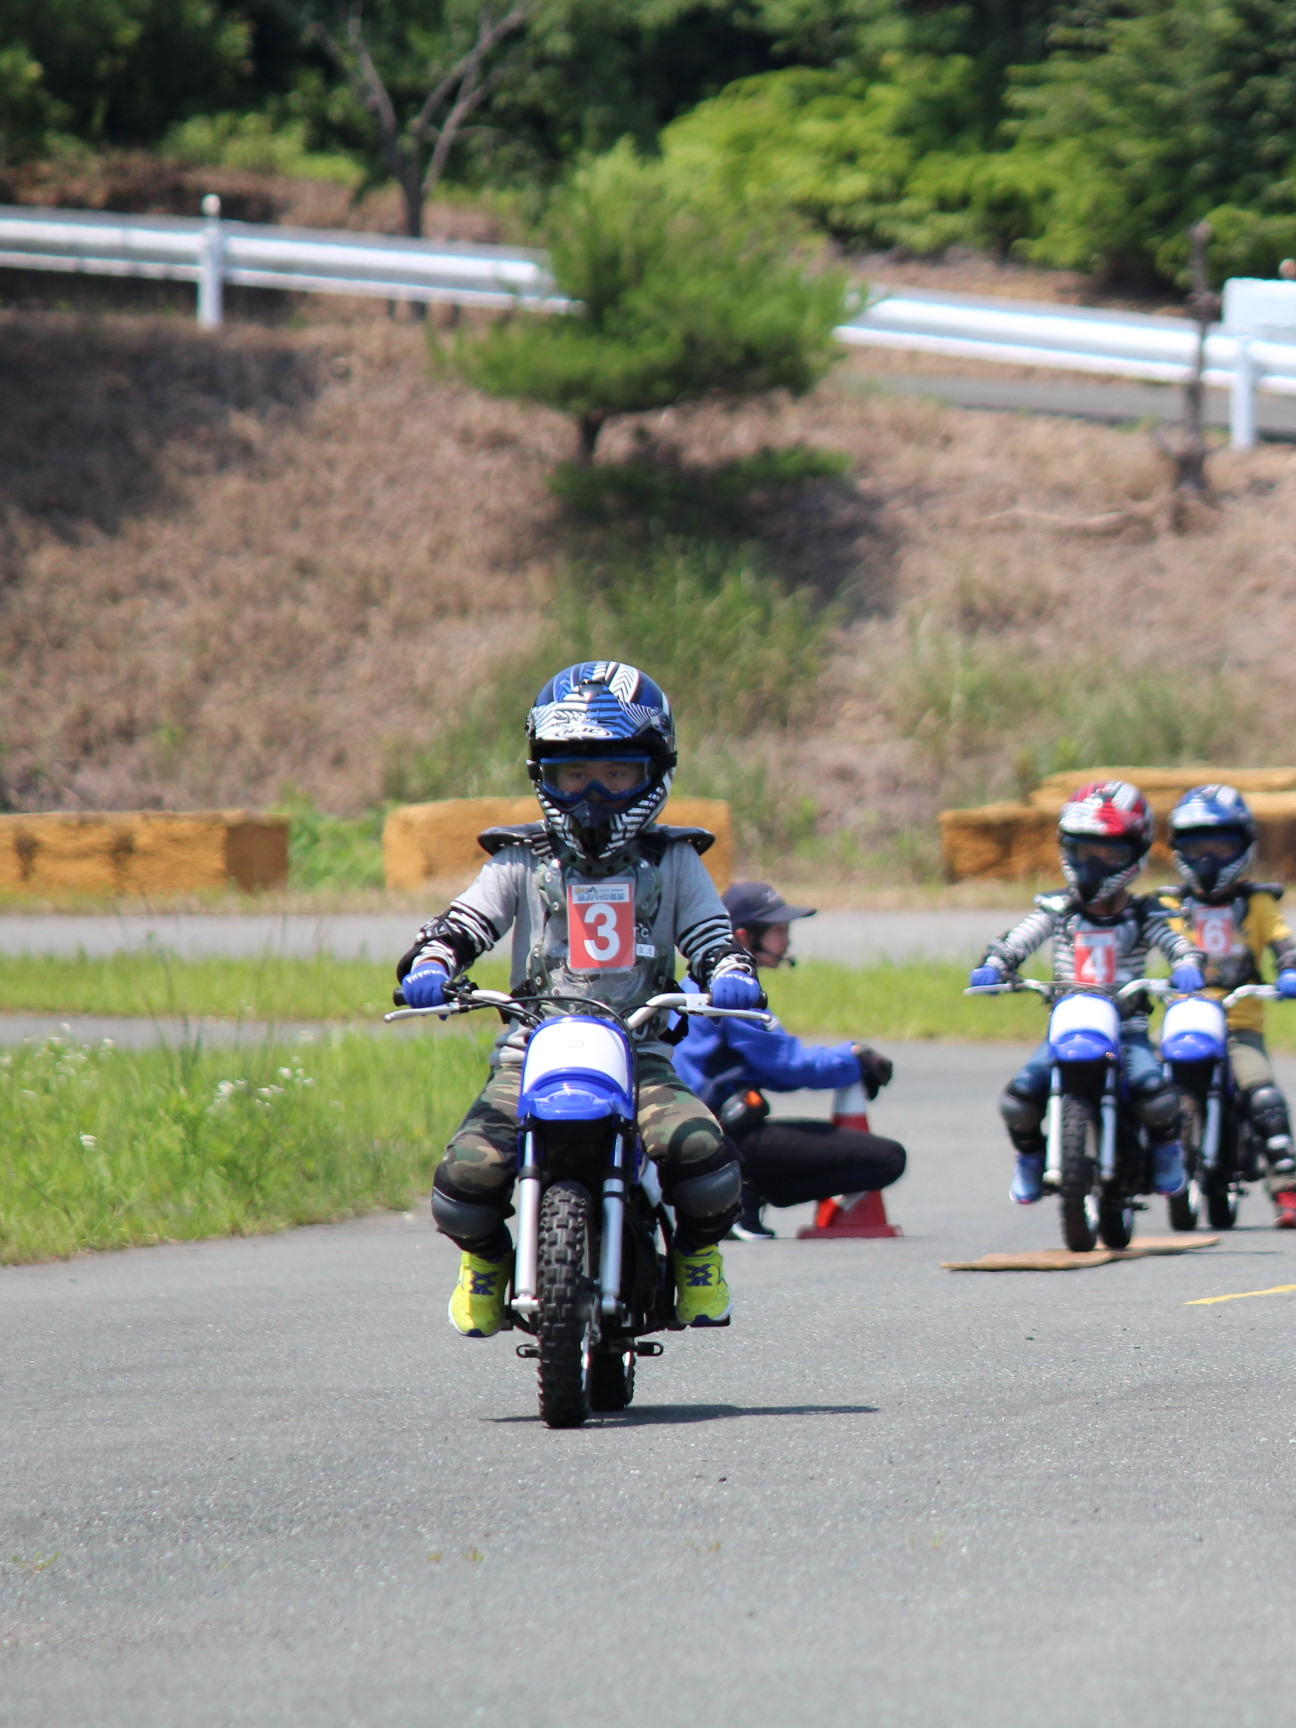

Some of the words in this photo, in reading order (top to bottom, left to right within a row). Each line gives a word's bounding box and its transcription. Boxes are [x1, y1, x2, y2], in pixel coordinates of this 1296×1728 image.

[584, 903, 620, 961] 3
[1203, 918, 1226, 952] 6
[1081, 944, 1108, 982] 4
